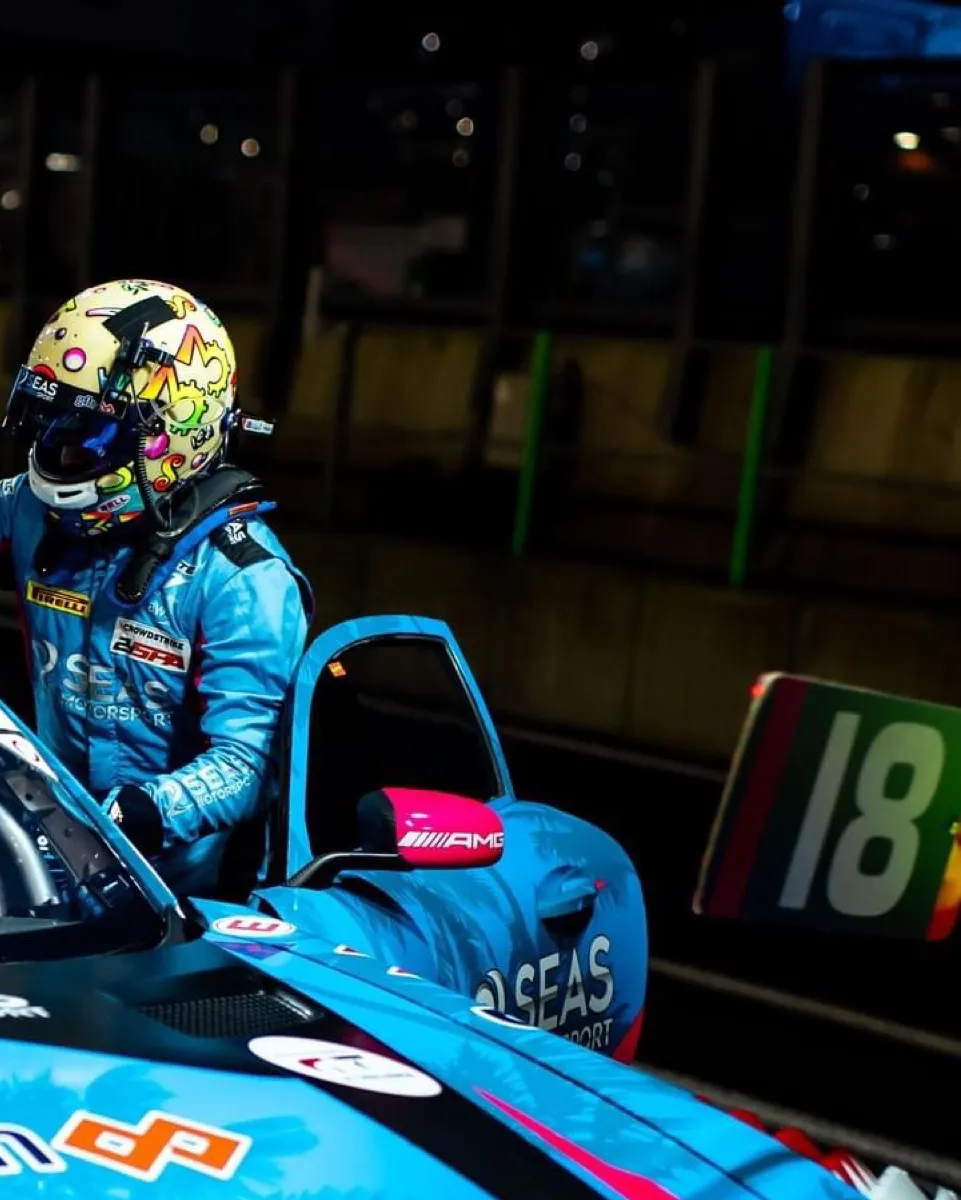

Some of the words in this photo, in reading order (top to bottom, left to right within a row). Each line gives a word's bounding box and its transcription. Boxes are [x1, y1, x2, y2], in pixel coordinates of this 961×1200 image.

[32, 586, 88, 613] PIRELLI
[123, 623, 185, 651] CROWDSTRIKE
[776, 710, 947, 918] 18
[447, 831, 504, 849] AMG
[515, 935, 615, 1030] SEAS
